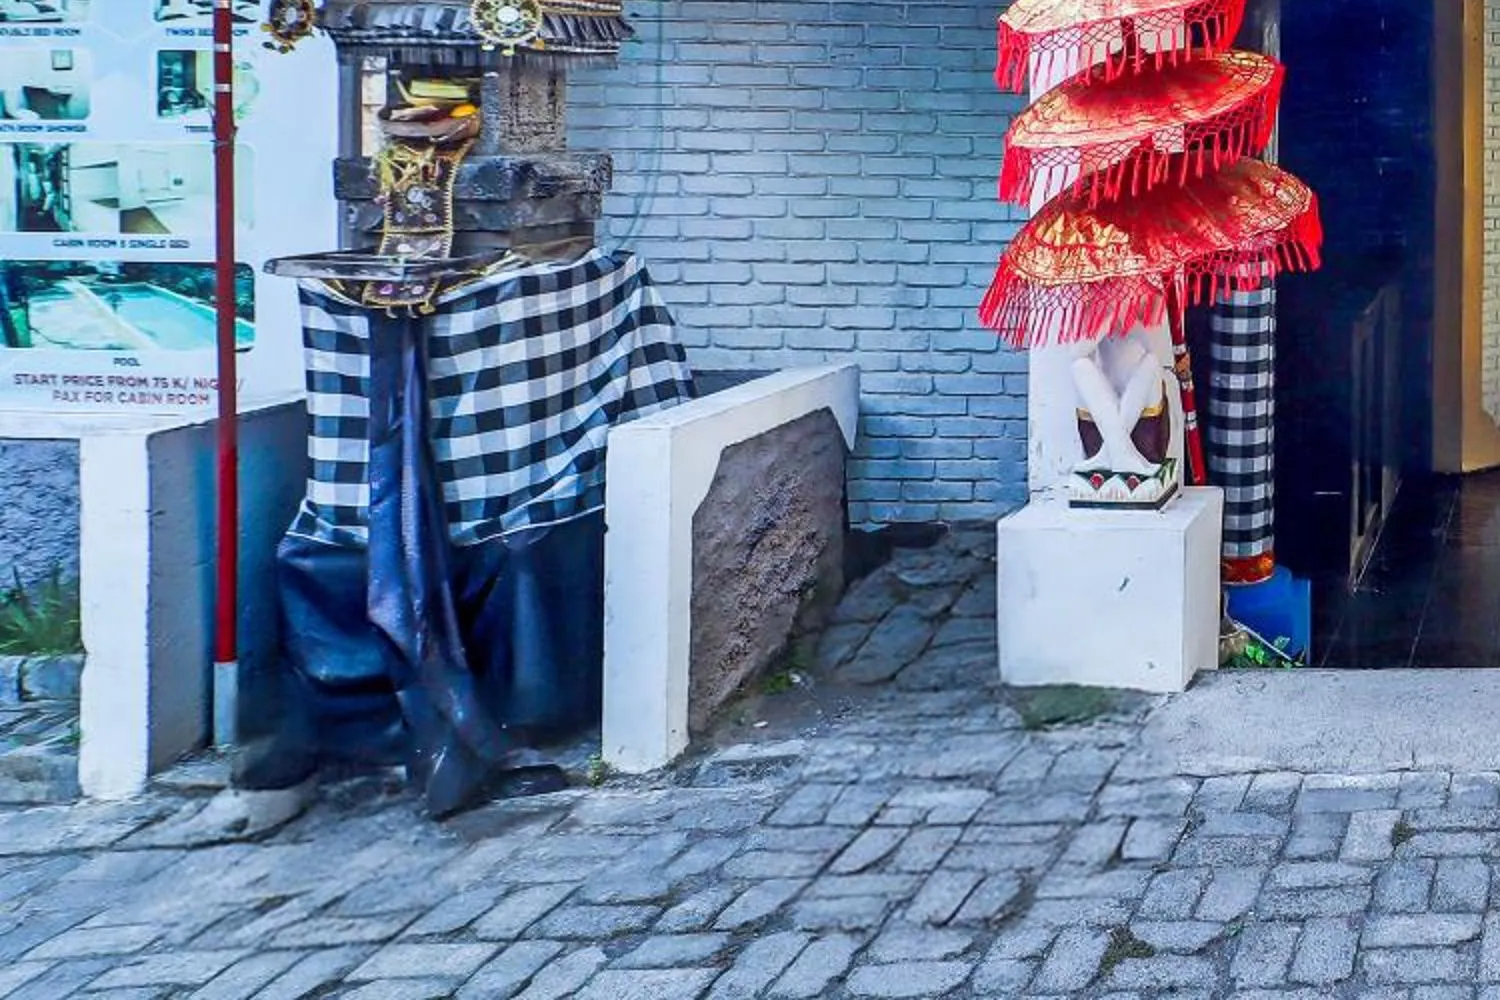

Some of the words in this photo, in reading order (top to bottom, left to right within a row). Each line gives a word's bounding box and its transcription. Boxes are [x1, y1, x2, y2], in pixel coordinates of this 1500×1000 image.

[113, 357, 141, 367] POOL
[13, 373, 57, 386] START
[62, 374, 104, 388] PRICE
[107, 375, 148, 389] FROM
[152, 376, 169, 389] 75
[85, 391, 113, 404] FOR
[118, 391, 162, 405] CABIN
[166, 392, 210, 406] ROOM
